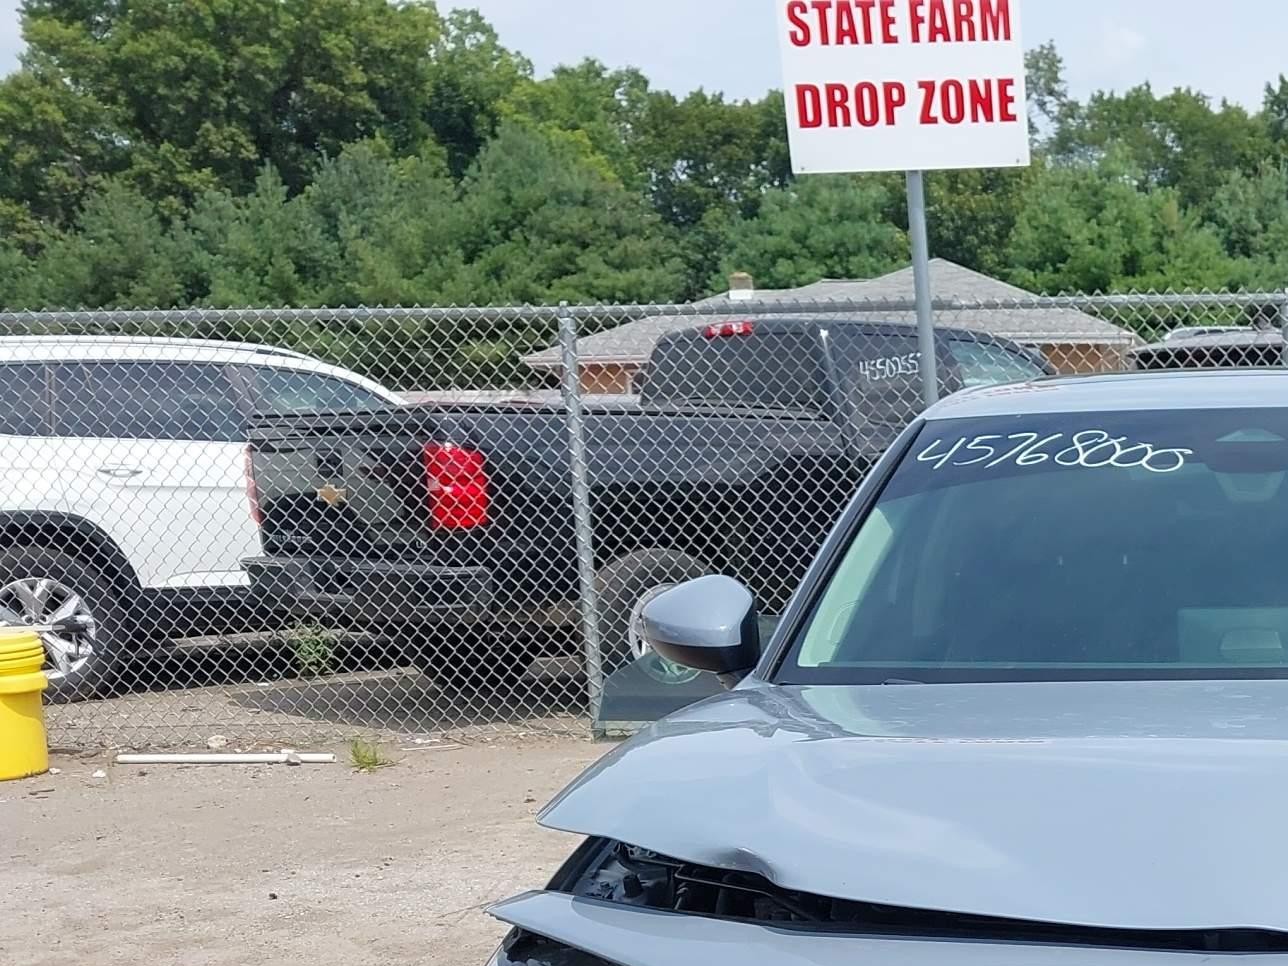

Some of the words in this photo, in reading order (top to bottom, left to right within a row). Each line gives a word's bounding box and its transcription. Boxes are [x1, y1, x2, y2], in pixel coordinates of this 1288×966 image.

[787, 0, 899, 46] STATE
[908, 0, 1012, 43] FARM
[795, 81, 906, 128] DROP
[917, 78, 1018, 124] ZONE
[858, 351, 922, 384] 4550255
[916, 429, 1193, 473] 45768000
